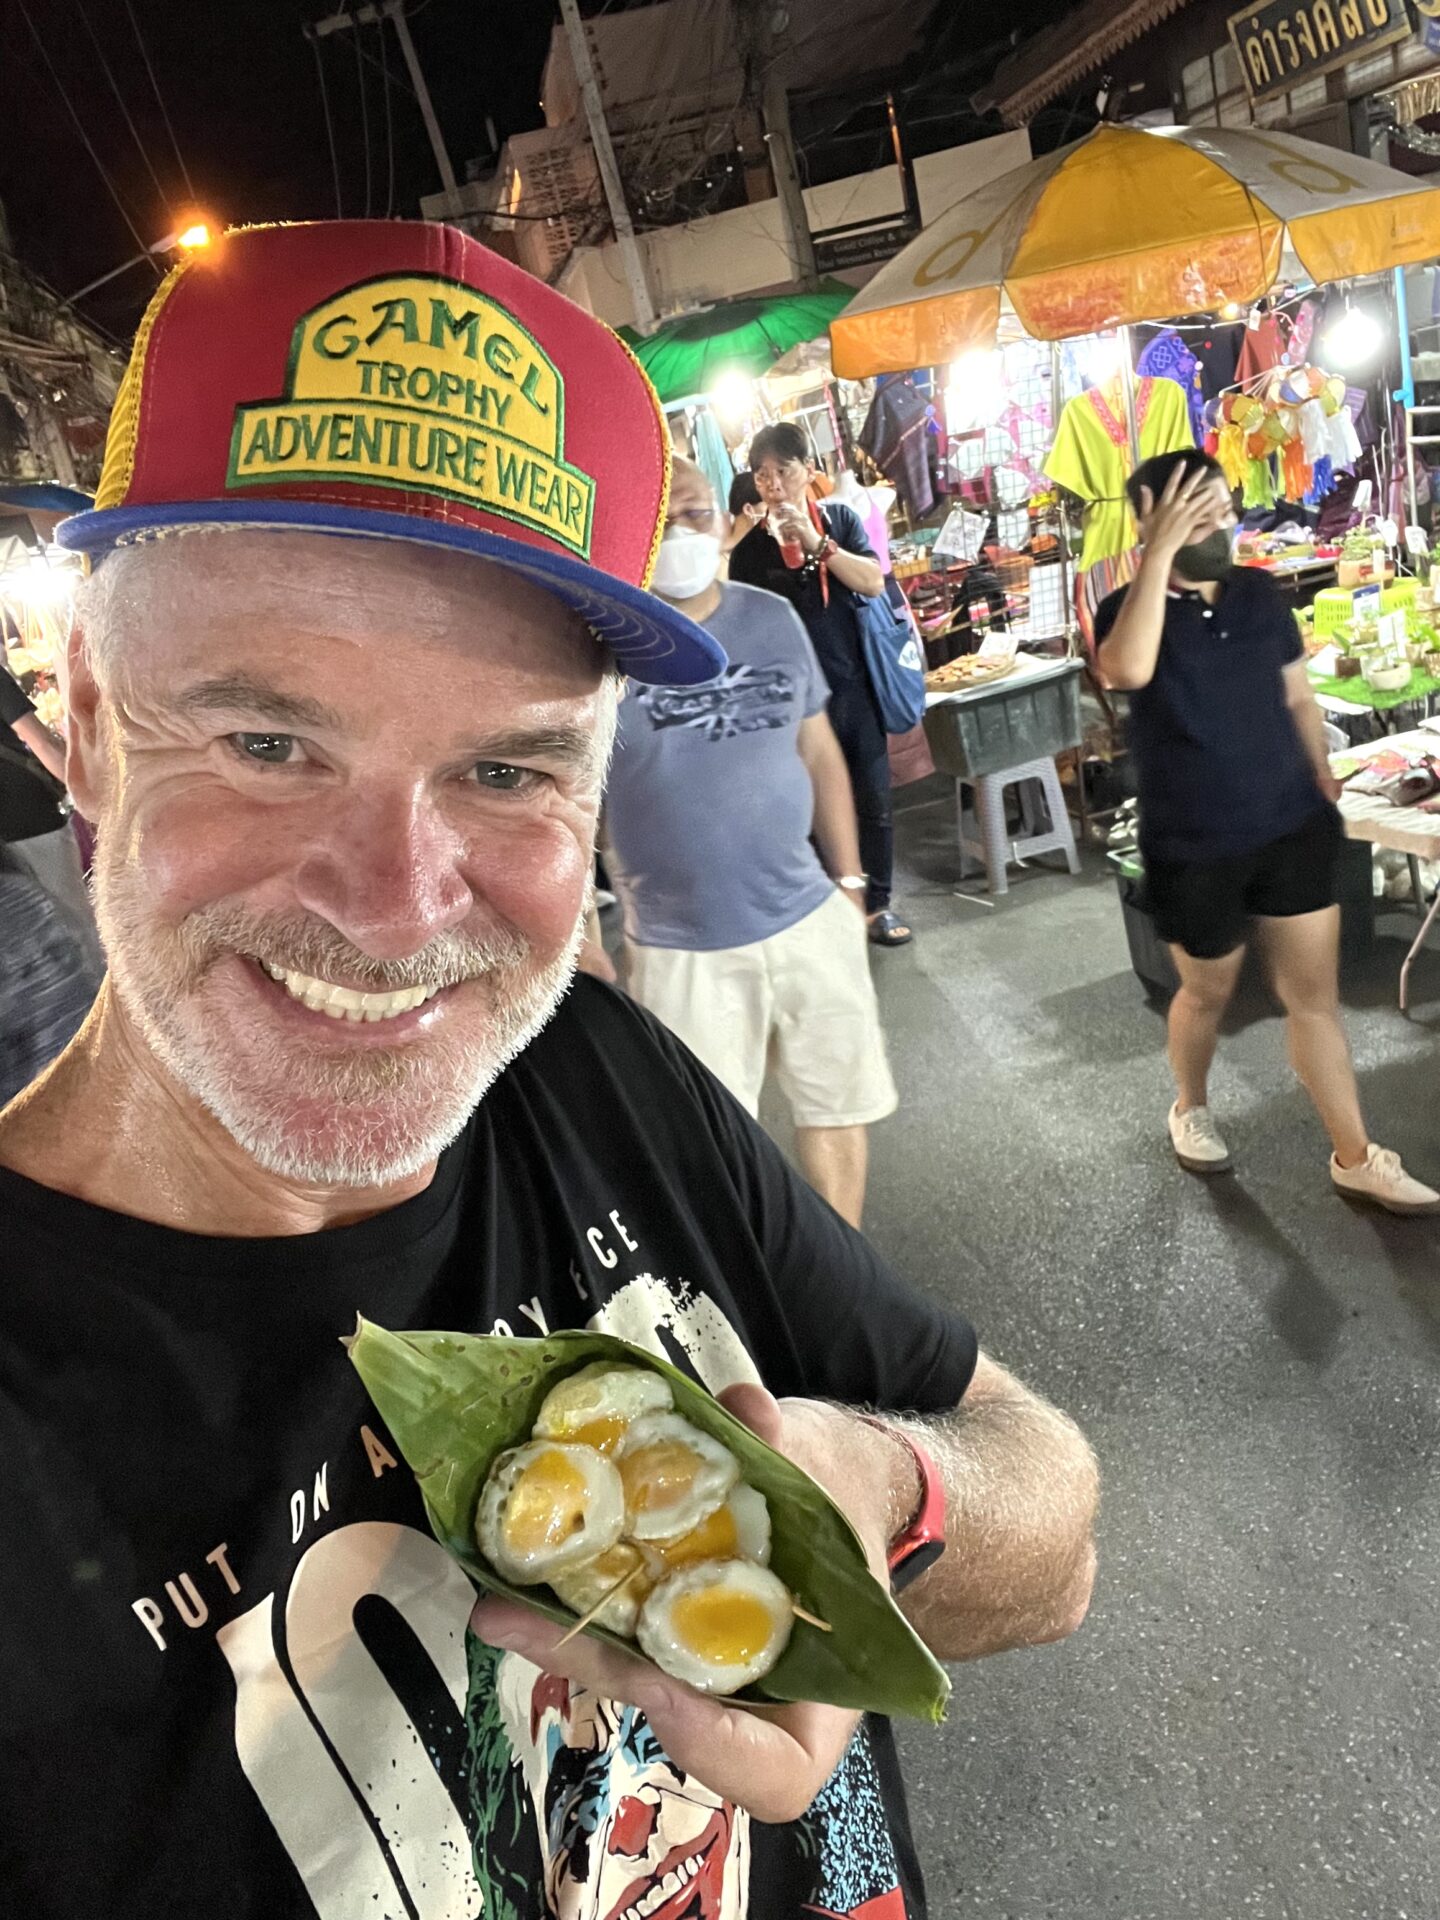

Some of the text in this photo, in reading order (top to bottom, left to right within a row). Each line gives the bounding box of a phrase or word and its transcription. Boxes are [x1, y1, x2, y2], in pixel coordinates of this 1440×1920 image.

[356, 359, 512, 427] TROPHY
[243, 413, 584, 535] ADVENTURE WEAR
[131, 1541, 241, 1651] PUT
[290, 1460, 330, 1544] ON
[360, 1424, 398, 1478] A
